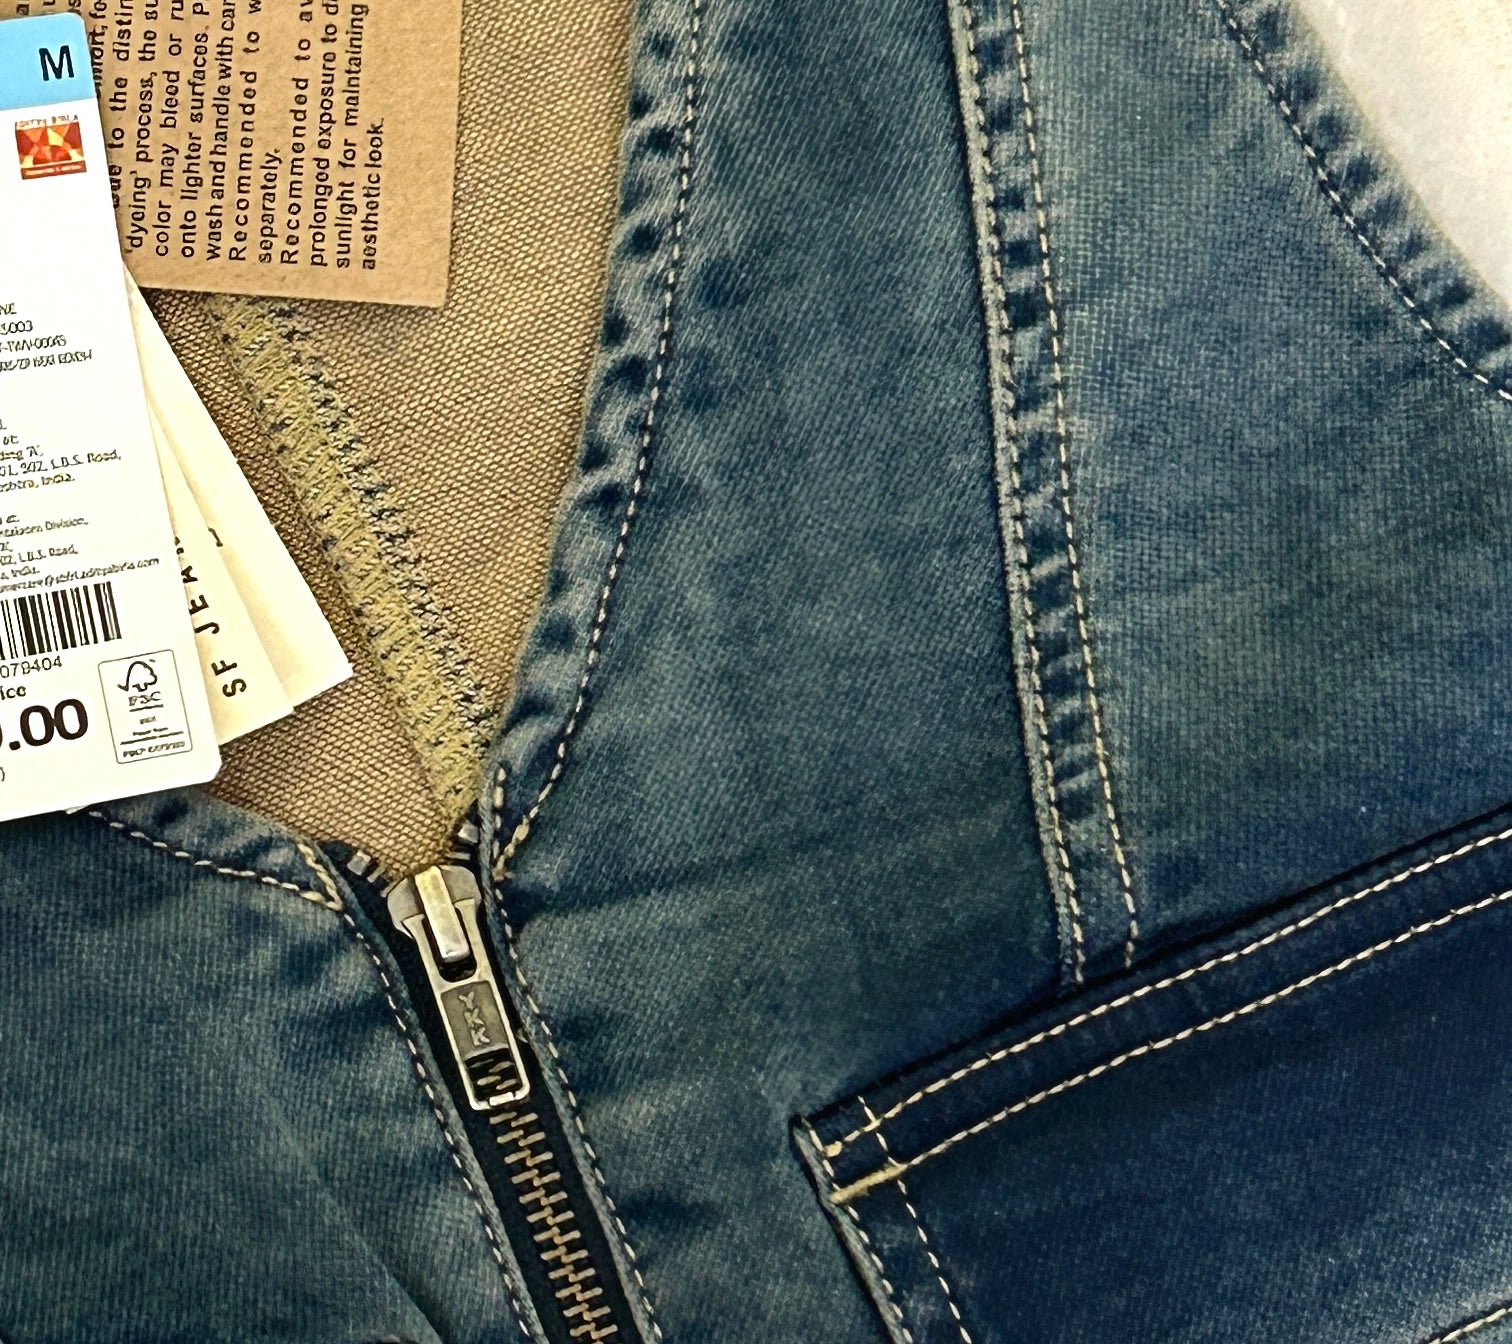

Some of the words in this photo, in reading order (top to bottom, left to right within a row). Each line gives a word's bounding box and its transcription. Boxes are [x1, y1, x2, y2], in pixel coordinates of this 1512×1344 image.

[138, 30, 156, 61] the
[168, 33, 183, 56] or
[215, 36, 234, 80] with
[242, 30, 260, 54] to
[294, 38, 311, 60] to
[321, 23, 338, 43] to
[38, 44, 75, 82] M
[342, 3, 370, 126] maintaining
[108, 77, 128, 111] the
[135, 71, 156, 162] process,
[160, 70, 181, 128] bleed
[209, 85, 231, 156] handle
[317, 52, 337, 150] exposure
[108, 127, 124, 149] to
[337, 138, 357, 169] for
[364, 118, 384, 168] look.
[160, 143, 179, 188] may
[180, 132, 203, 200] lighter
[208, 161, 226, 200] and
[229, 70, 257, 261] Recommended
[280, 77, 309, 265] Recommended
[153, 200, 173, 257] color
[205, 204, 223, 260] wash
[258, 148, 282, 263] separately.
[308, 157, 333, 267] prolonged
[334, 182, 358, 269] sunlight
[360, 173, 382, 270] aesthetic
[180, 211, 197, 257] onto
[174, 535, 220, 635] JEA
[212, 658, 248, 698] SF
